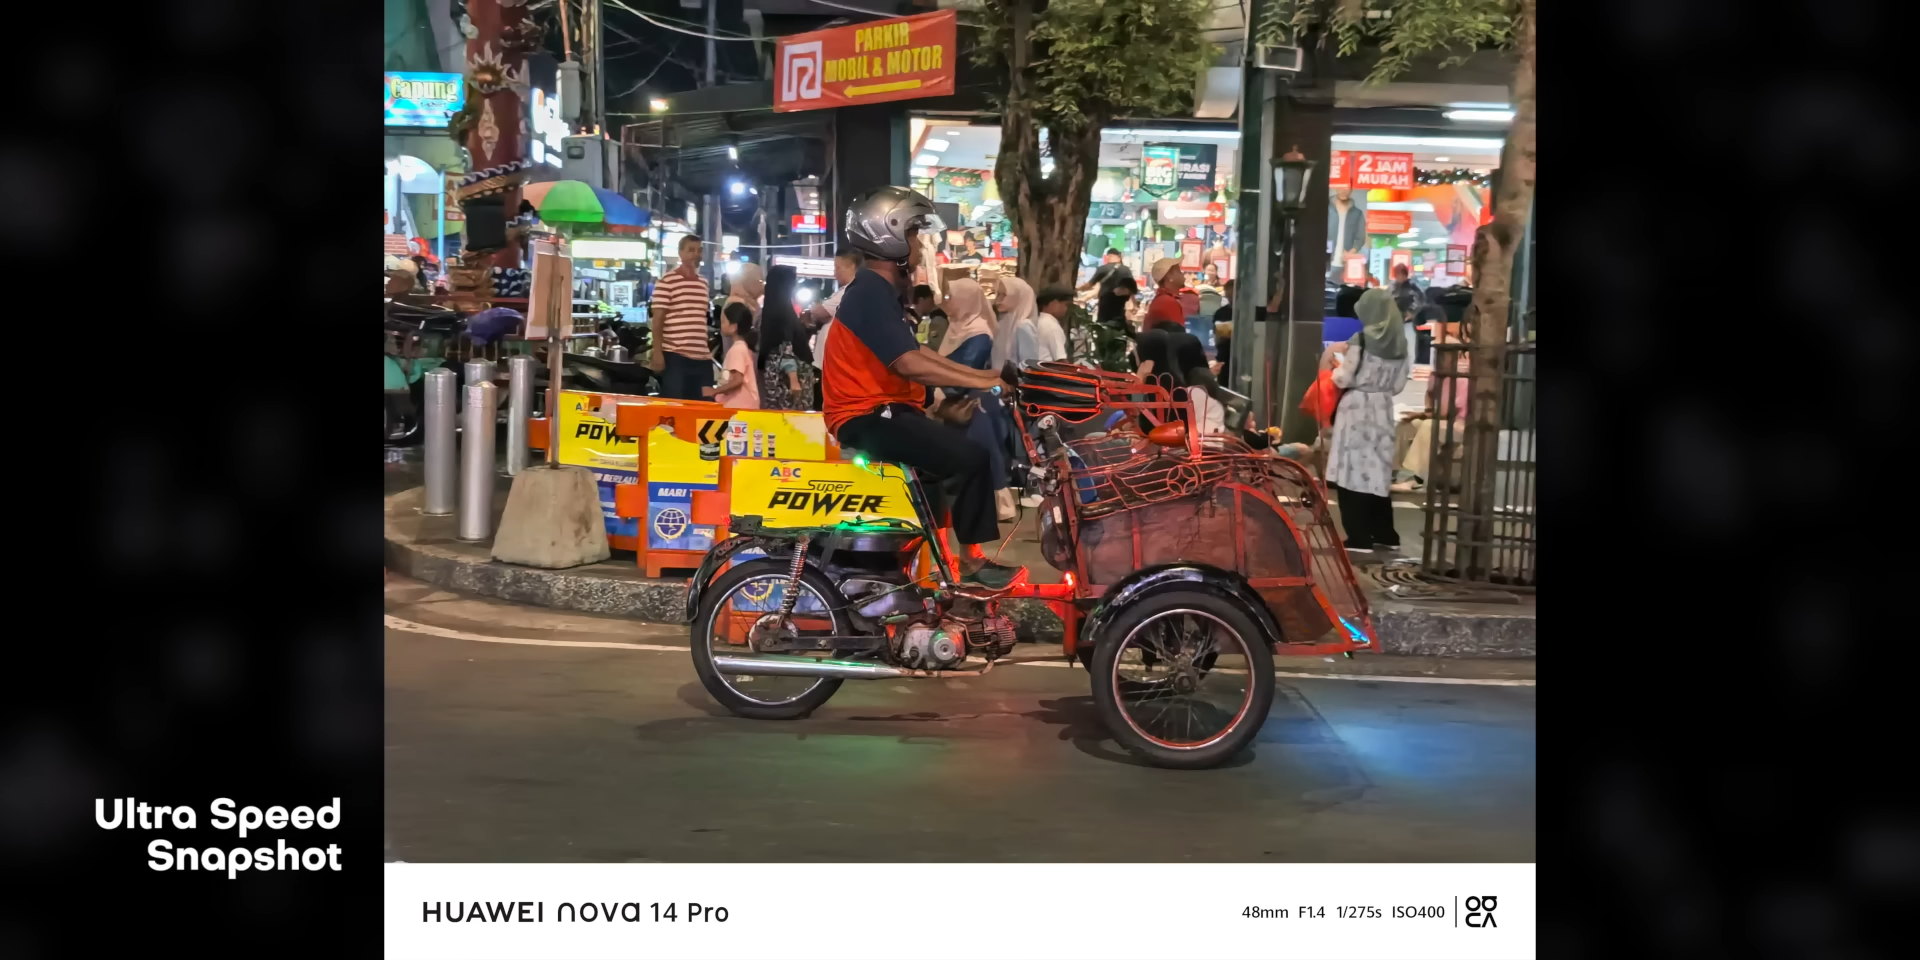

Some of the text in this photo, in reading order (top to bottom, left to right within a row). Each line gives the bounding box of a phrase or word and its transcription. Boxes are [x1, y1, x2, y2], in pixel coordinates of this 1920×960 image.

[855, 22, 909, 53] PARKIR
[824, 44, 942, 83] MOBIL & MOTOR
[390, 77, 458, 102] Capung
[1358, 154, 1408, 173] 2 JAM
[1145, 166, 1173, 178] BIG
[1145, 177, 1172, 186] SALE
[1357, 173, 1409, 186] MURAH
[1100, 204, 1115, 216] 75
[575, 423, 637, 447] POW
[728, 426, 747, 434] ABC
[770, 467, 801, 478] ABC
[658, 488, 687, 497] MARI
[808, 480, 854, 493] Super
[768, 491, 890, 516] POWER
